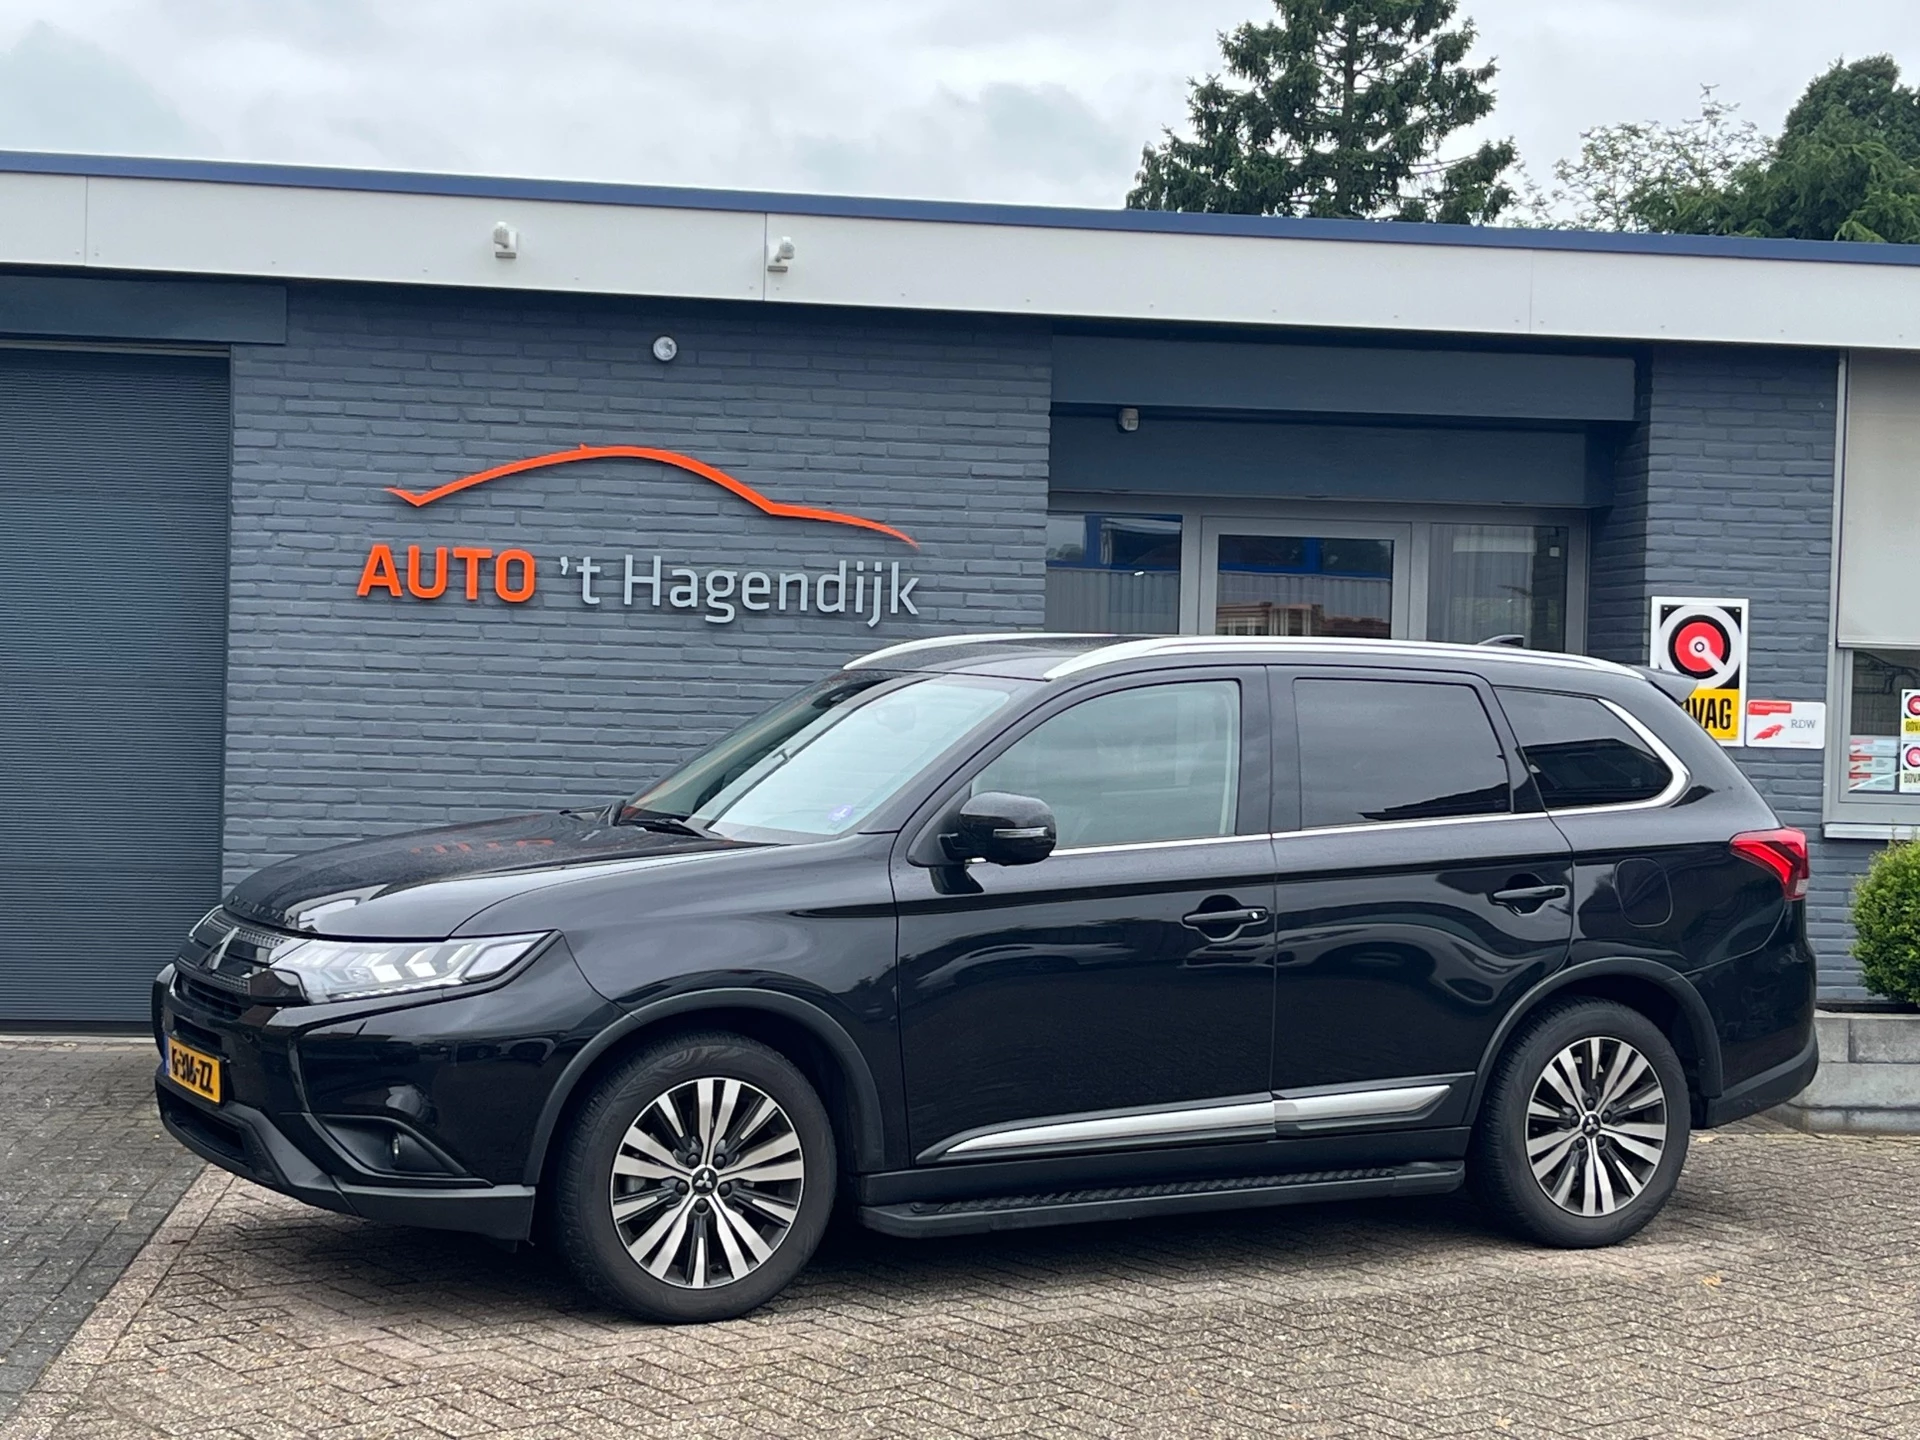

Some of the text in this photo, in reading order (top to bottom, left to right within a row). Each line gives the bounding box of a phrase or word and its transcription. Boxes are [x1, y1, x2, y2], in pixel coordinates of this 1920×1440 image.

[357, 544, 535, 603] AUTO
[624, 553, 920, 628] Hagendijk
[1790, 718, 1817, 729] RDW
